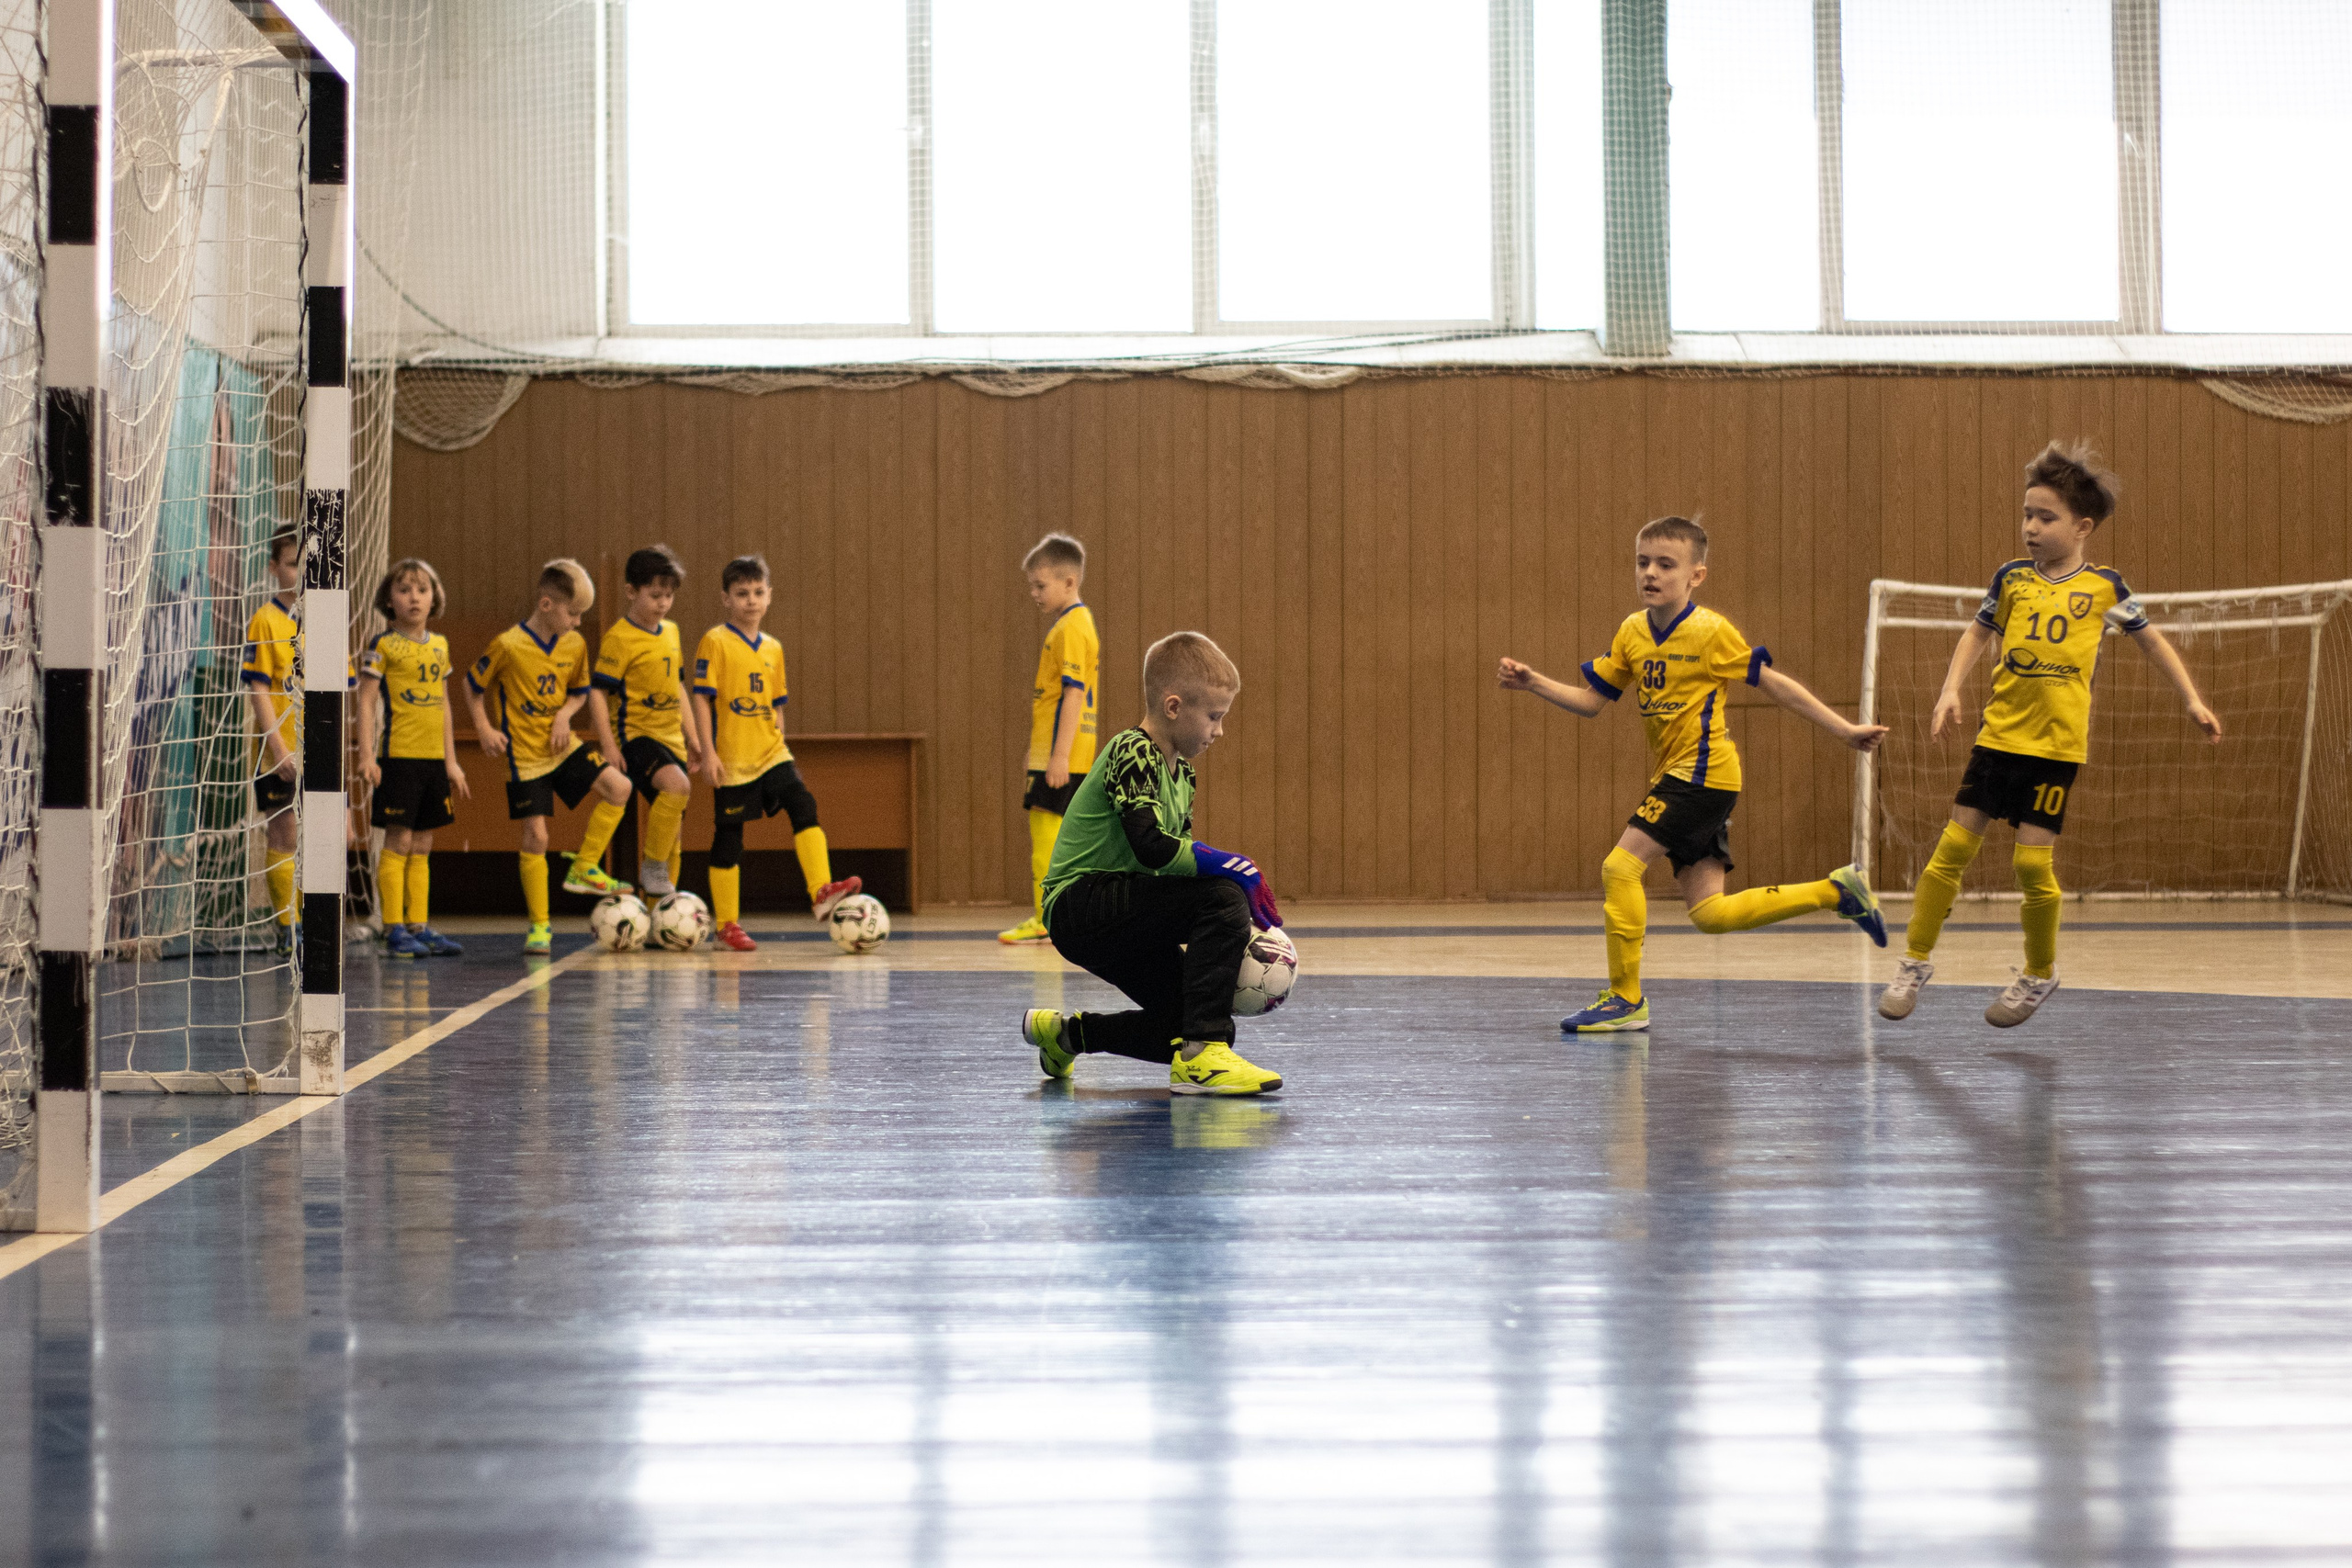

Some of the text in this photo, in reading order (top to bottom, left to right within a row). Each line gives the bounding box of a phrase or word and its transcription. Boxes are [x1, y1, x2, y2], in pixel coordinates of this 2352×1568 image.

[2025, 612, 2068, 644] 10
[418, 663, 440, 682] 19
[662, 657, 671, 677] 7
[1643, 660, 1667, 690] 33
[537, 672, 557, 695] 23
[749, 672, 763, 694] 15
[1636, 795, 1667, 824] 33
[2032, 783, 2065, 816] 10
[865, 902, 879, 935] SELECT
